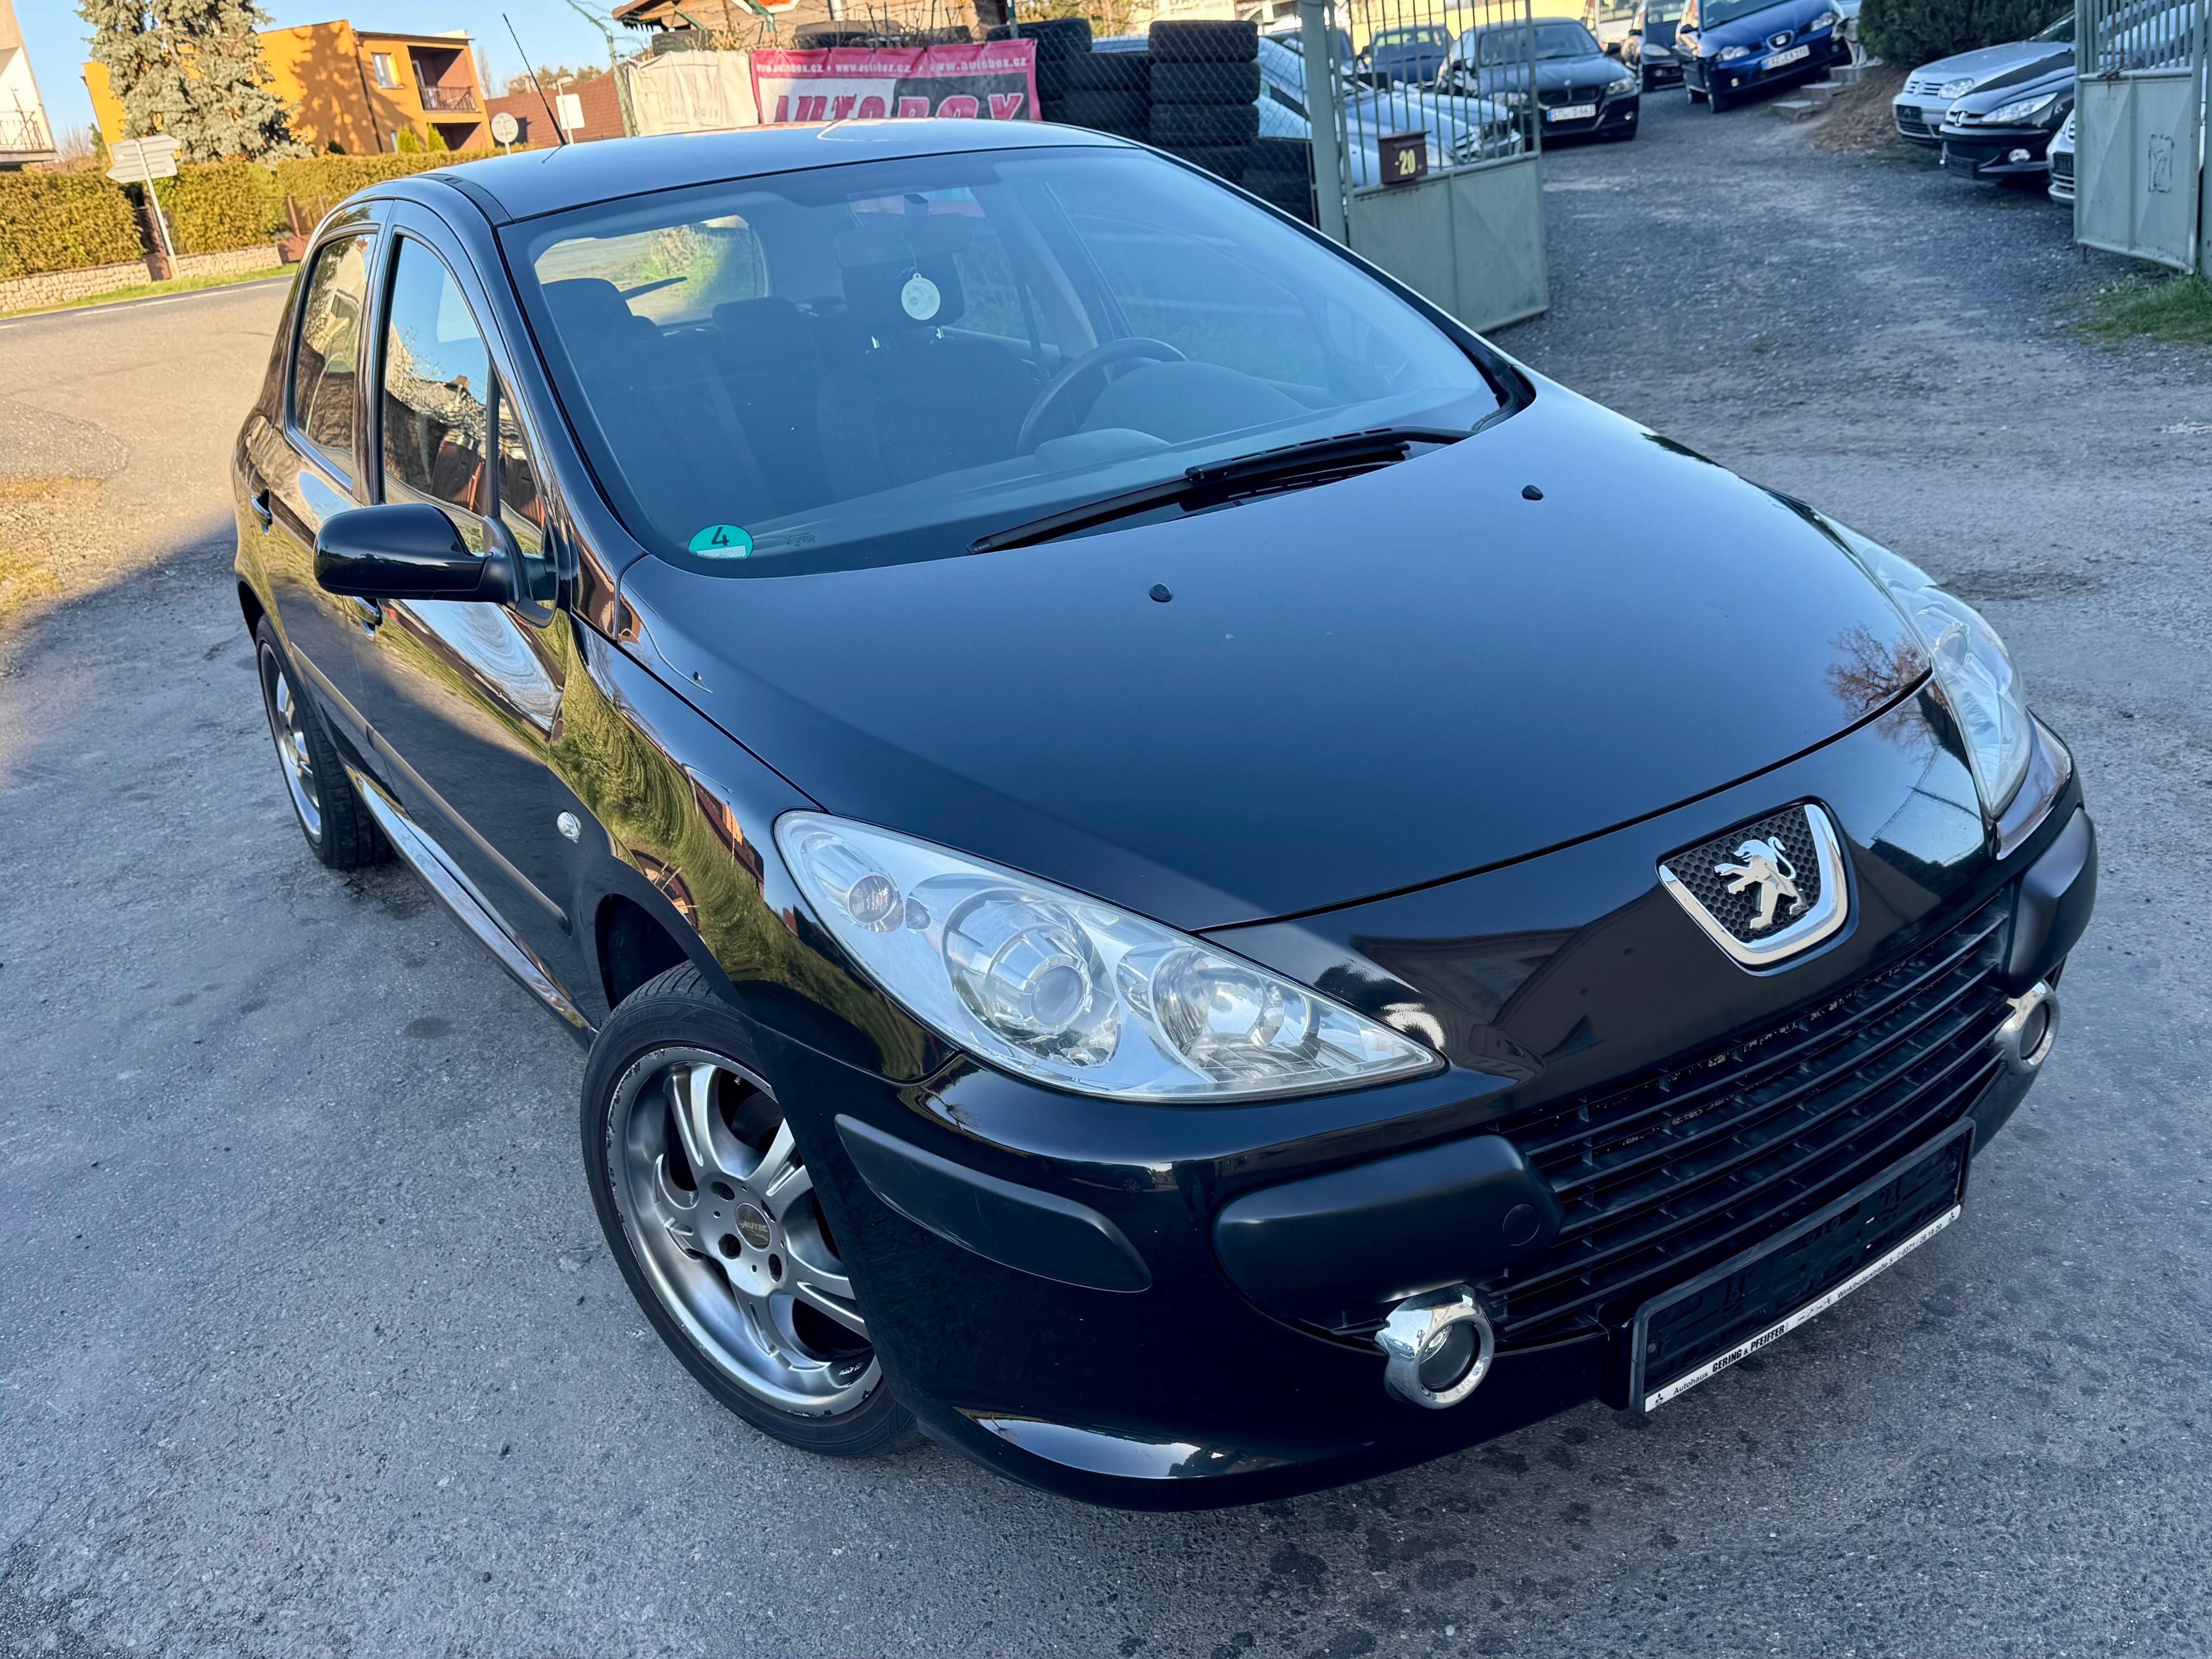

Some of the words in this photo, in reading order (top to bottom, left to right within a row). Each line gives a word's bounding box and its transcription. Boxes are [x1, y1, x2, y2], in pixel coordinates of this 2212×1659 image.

[1399, 149, 1415, 176] 20
[711, 526, 729, 547] 4
[739, 1220, 768, 1233] AUTEC
[1674, 1371, 1708, 1395] Autohaus
[1712, 1348, 1742, 1373] GERING
[1743, 1347, 1749, 1355] &
[1750, 1324, 1785, 1351] PFEIFFER
